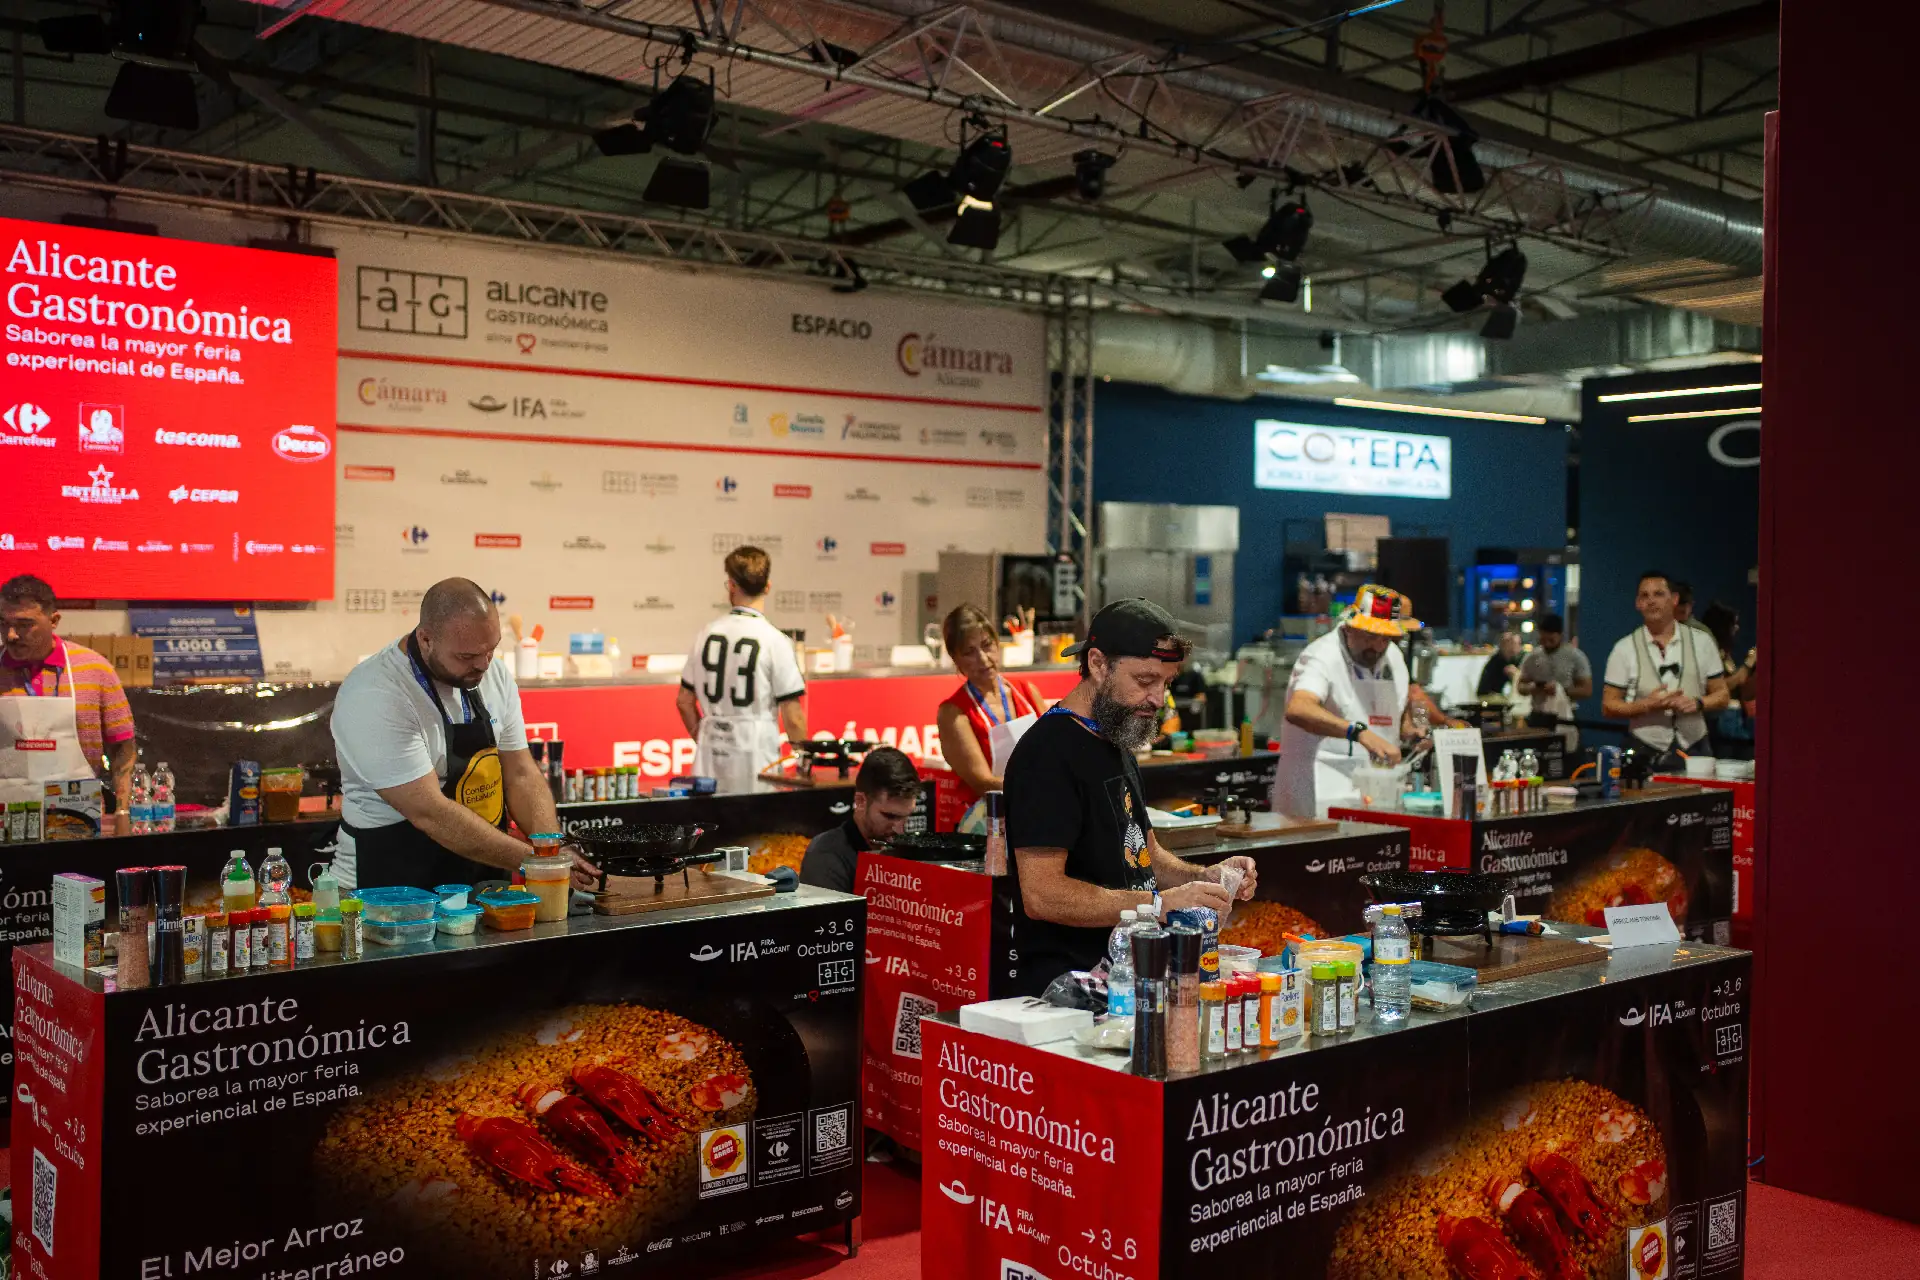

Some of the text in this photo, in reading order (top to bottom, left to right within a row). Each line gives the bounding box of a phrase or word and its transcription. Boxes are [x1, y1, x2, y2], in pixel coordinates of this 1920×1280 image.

[6, 239, 177, 291] Alicante
[7, 283, 293, 344] Gastronómica
[791, 313, 872, 341] ESPACIO
[5, 324, 241, 362] Saborea la mayor feria
[896, 332, 1013, 377] Cámara
[6, 352, 244, 385] experiencial de España.
[358, 376, 448, 406] Cámara
[512, 396, 547, 420] IFA
[155, 427, 241, 448] tescoma.
[1268, 429, 1440, 471] COTEPA
[701, 633, 760, 707] 93
[1481, 829, 1534, 850] Alicante
[865, 863, 922, 892] Alicante
[1328, 858, 1346, 874] IFA
[1367, 861, 1401, 872] Octubre
[1481, 846, 1568, 874] Gastronómica
[16, 912, 50, 924] feria
[157, 919, 183, 931] Pimie
[863, 886, 964, 927] Gastronómica
[867, 912, 895, 924] aborea
[0, 926, 53, 942] España.
[828, 919, 854, 936] 3_6
[867, 926, 907, 940] periencial
[730, 938, 854, 962] IFA FIRA ALACANT Octubre
[17, 963, 54, 1008] Alicante
[885, 956, 911, 977] IFA
[932, 978, 977, 1000] Octubre
[955, 964, 977, 982] 3_6
[1723, 978, 1742, 996] 3_6
[17, 996, 84, 1063] Gatronómica
[134, 996, 299, 1042] Alicante
[1649, 1003, 1672, 1028] IFA
[1701, 1002, 1741, 1021] Octubre
[137, 1020, 412, 1086] Gastronómica
[937, 1040, 1035, 1096] Alicante
[135, 1061, 360, 1112] Saborea la mayor feria
[135, 1084, 364, 1137] experiencial de España.
[939, 1078, 1117, 1165] Gastronómica
[1186, 1080, 1320, 1142] Alicante
[938, 1114, 1074, 1176] Saborea la mayor feria
[1190, 1106, 1405, 1193] Gastronómica
[726, 1174, 746, 1187] POPULAR
[938, 1138, 1077, 1200] experiencial de España.
[1190, 1157, 1364, 1224] Saborea la mayor feria
[980, 1195, 1014, 1235] IFA
[1016, 1208, 1050, 1246] FIRA ALACANT
[1190, 1183, 1366, 1254] experiencial de España.
[141, 1218, 364, 1280] El Mejor Arroz
[260, 1246, 405, 1280] iterráneo
[1101, 1228, 1137, 1260] 3_6
